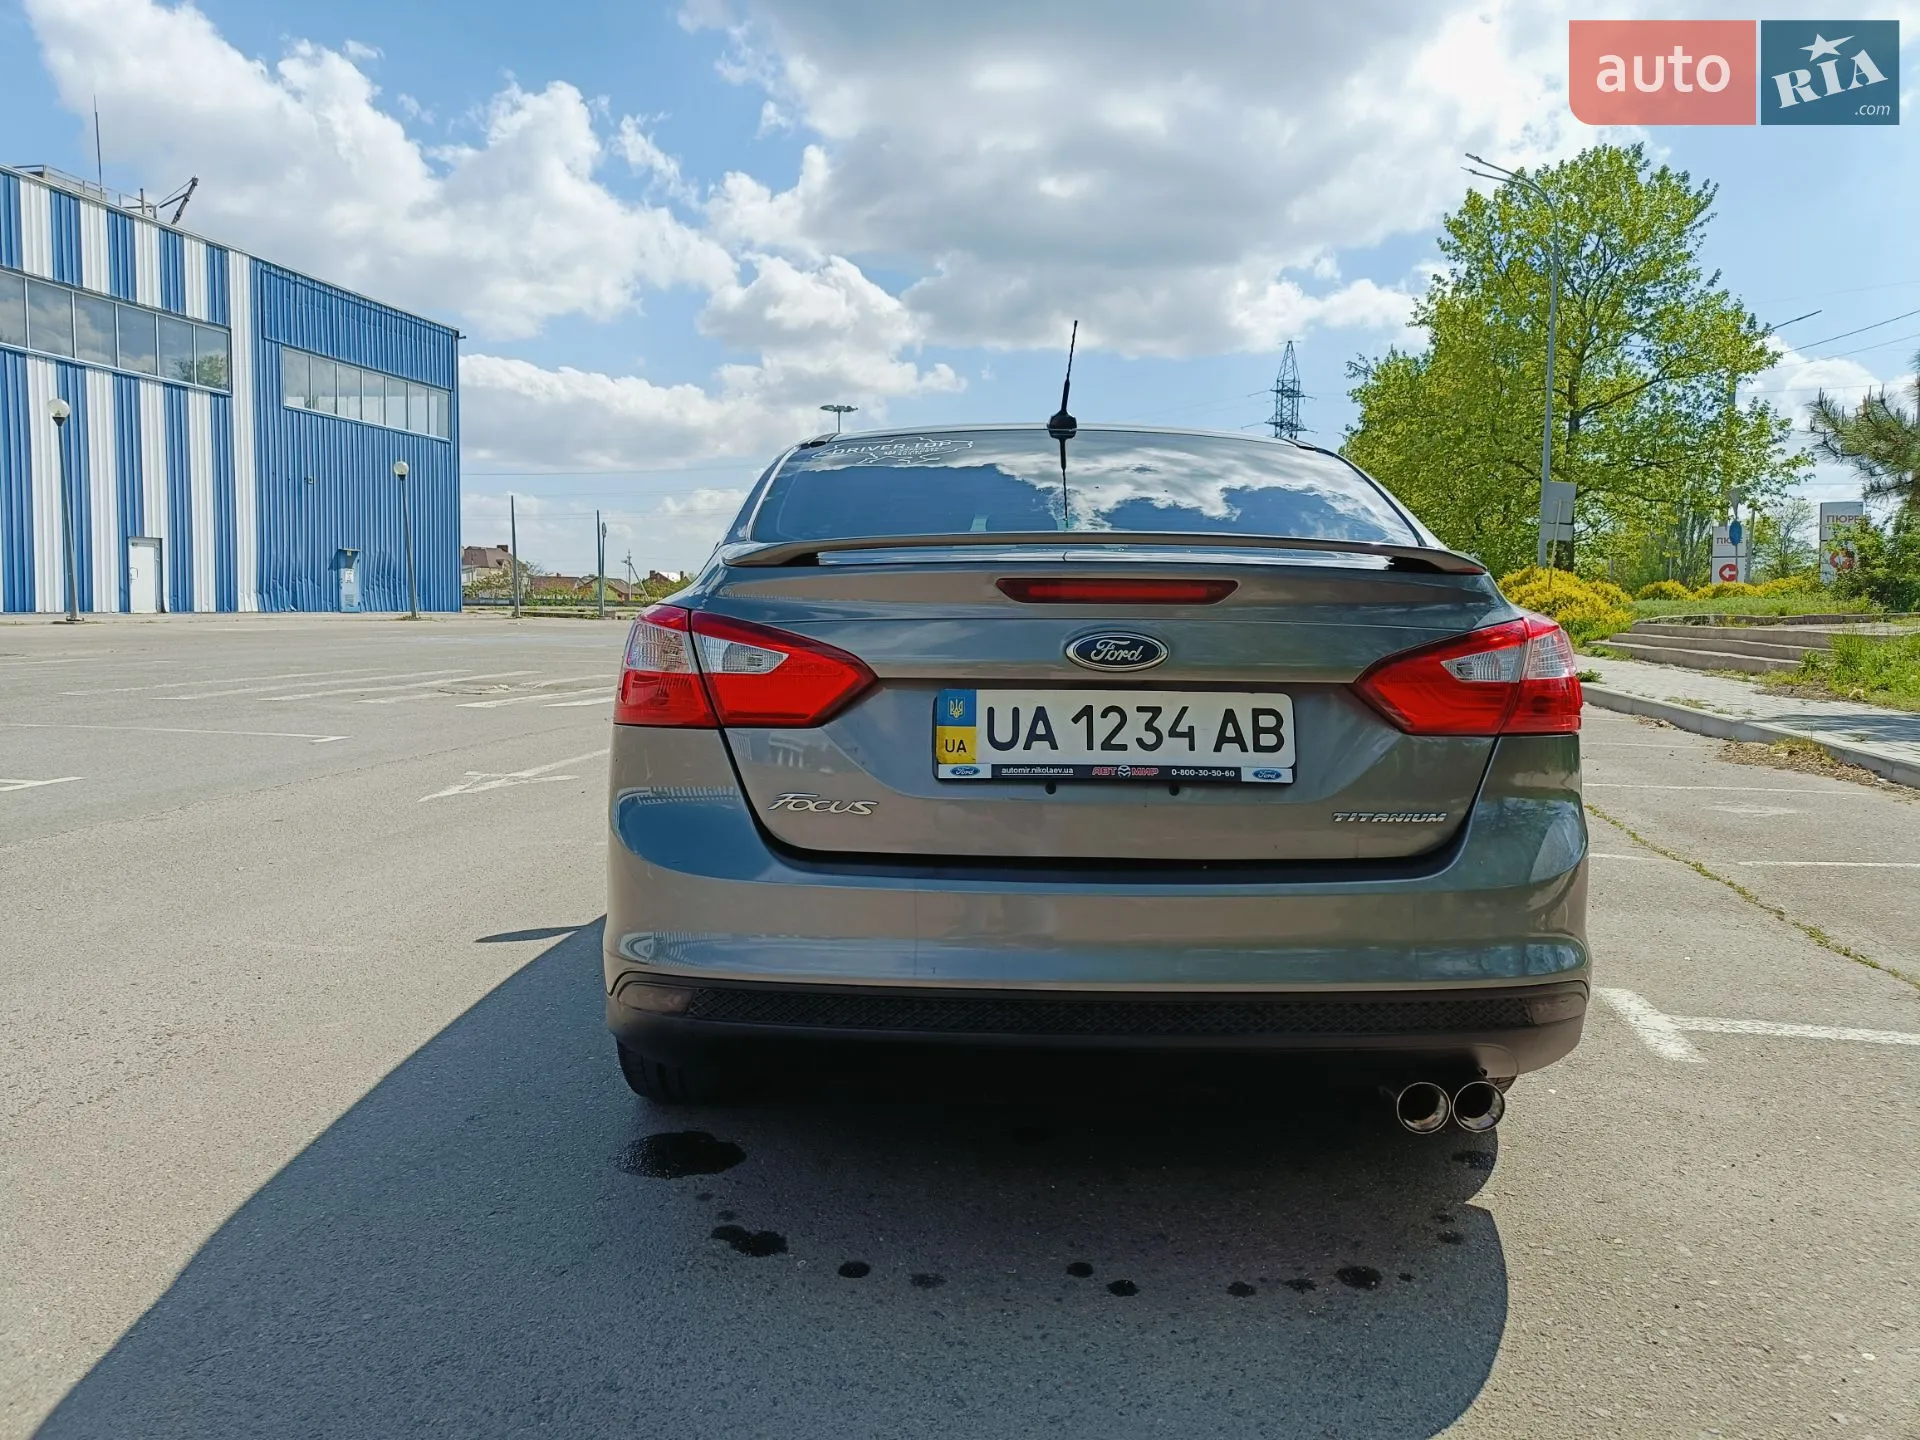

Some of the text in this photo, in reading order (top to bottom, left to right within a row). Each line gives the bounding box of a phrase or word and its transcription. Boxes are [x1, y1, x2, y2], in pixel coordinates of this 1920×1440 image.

[1090, 639, 1144, 661] Ford
[987, 704, 1285, 753] UA 1234 AB
[945, 739, 967, 753] UA
[955, 766, 975, 775] Ford
[1001, 766, 1074, 776] automir.nikolaev.ua
[1171, 769, 1235, 777] 0-800-30-50-60
[1333, 812, 1448, 823] TITANIUM
